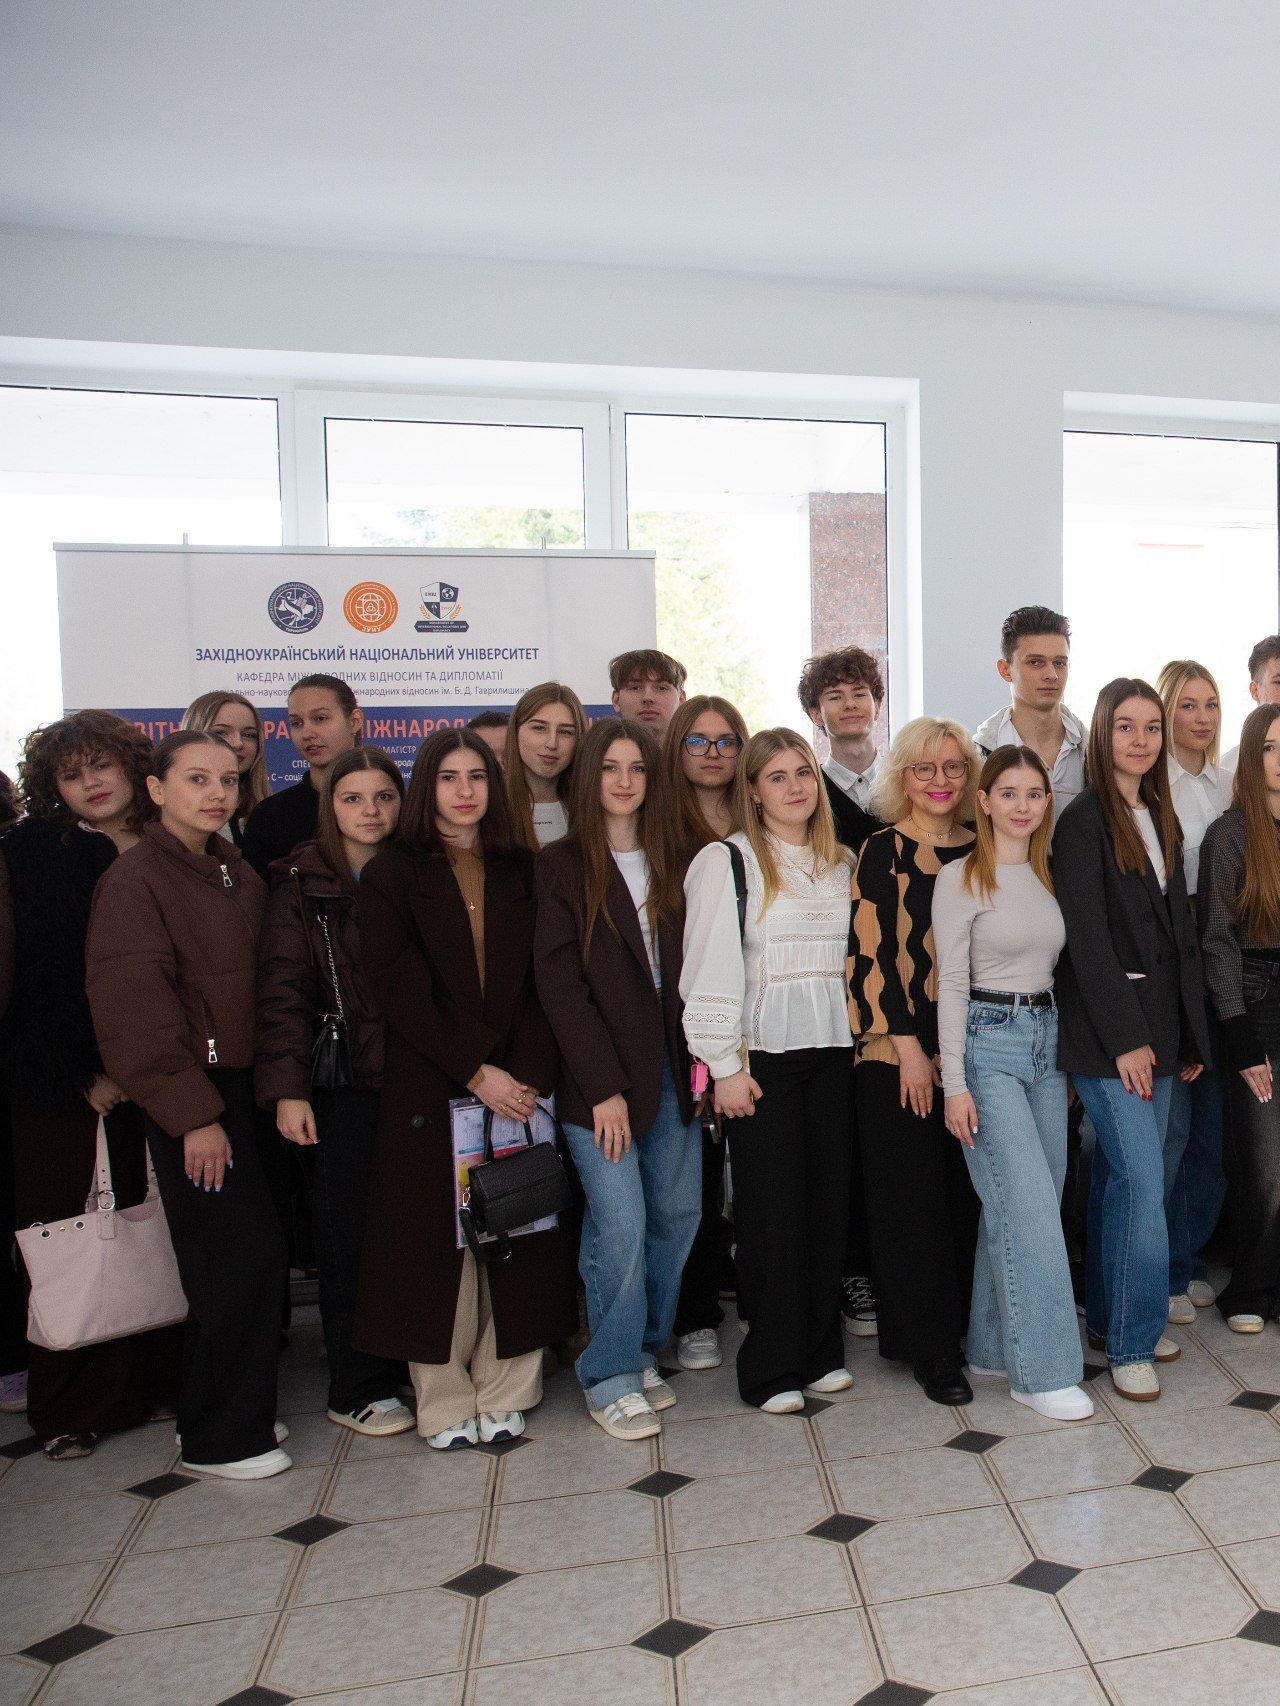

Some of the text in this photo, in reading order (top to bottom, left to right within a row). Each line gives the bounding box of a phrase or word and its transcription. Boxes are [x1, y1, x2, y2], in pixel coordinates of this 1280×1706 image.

[195, 645, 539, 664] ЗАХІДНОУКРАЇНСЬКИЙ НАЦІОНАЛЬНИЙ УНІВЕРСИТЕТ
[237, 672, 285, 684] КАФЕДРА
[369, 671, 423, 683] ВІДНОСИН
[425, 671, 437, 681] ТА
[439, 669, 504, 683] ДИПЛОМАТІЇ
[402, 686, 438, 696] відносин
[454, 686, 462, 695] Б.
